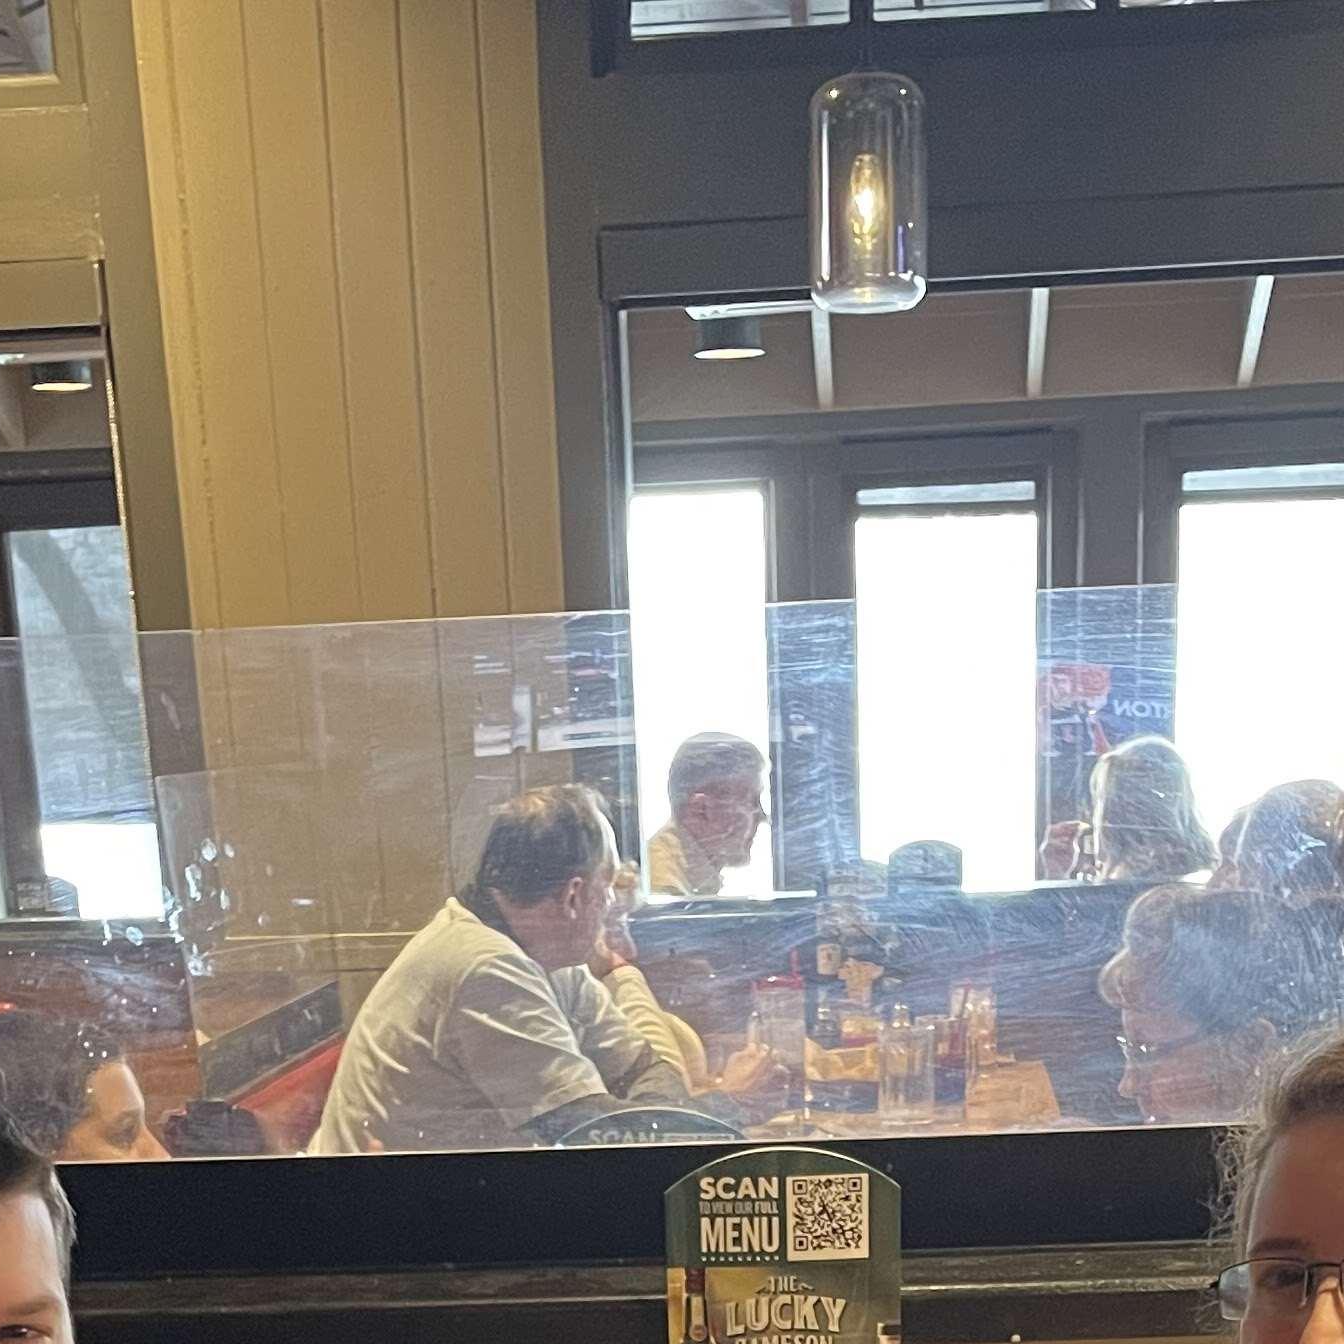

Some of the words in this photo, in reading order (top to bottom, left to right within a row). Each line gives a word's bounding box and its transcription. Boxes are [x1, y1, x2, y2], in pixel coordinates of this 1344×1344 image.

[699, 1176, 779, 1200] SCAN
[754, 1201, 779, 1214] FULL
[700, 1216, 780, 1253] MENU
[768, 1276, 798, 1292] THE
[725, 1295, 847, 1336] LUCKY
